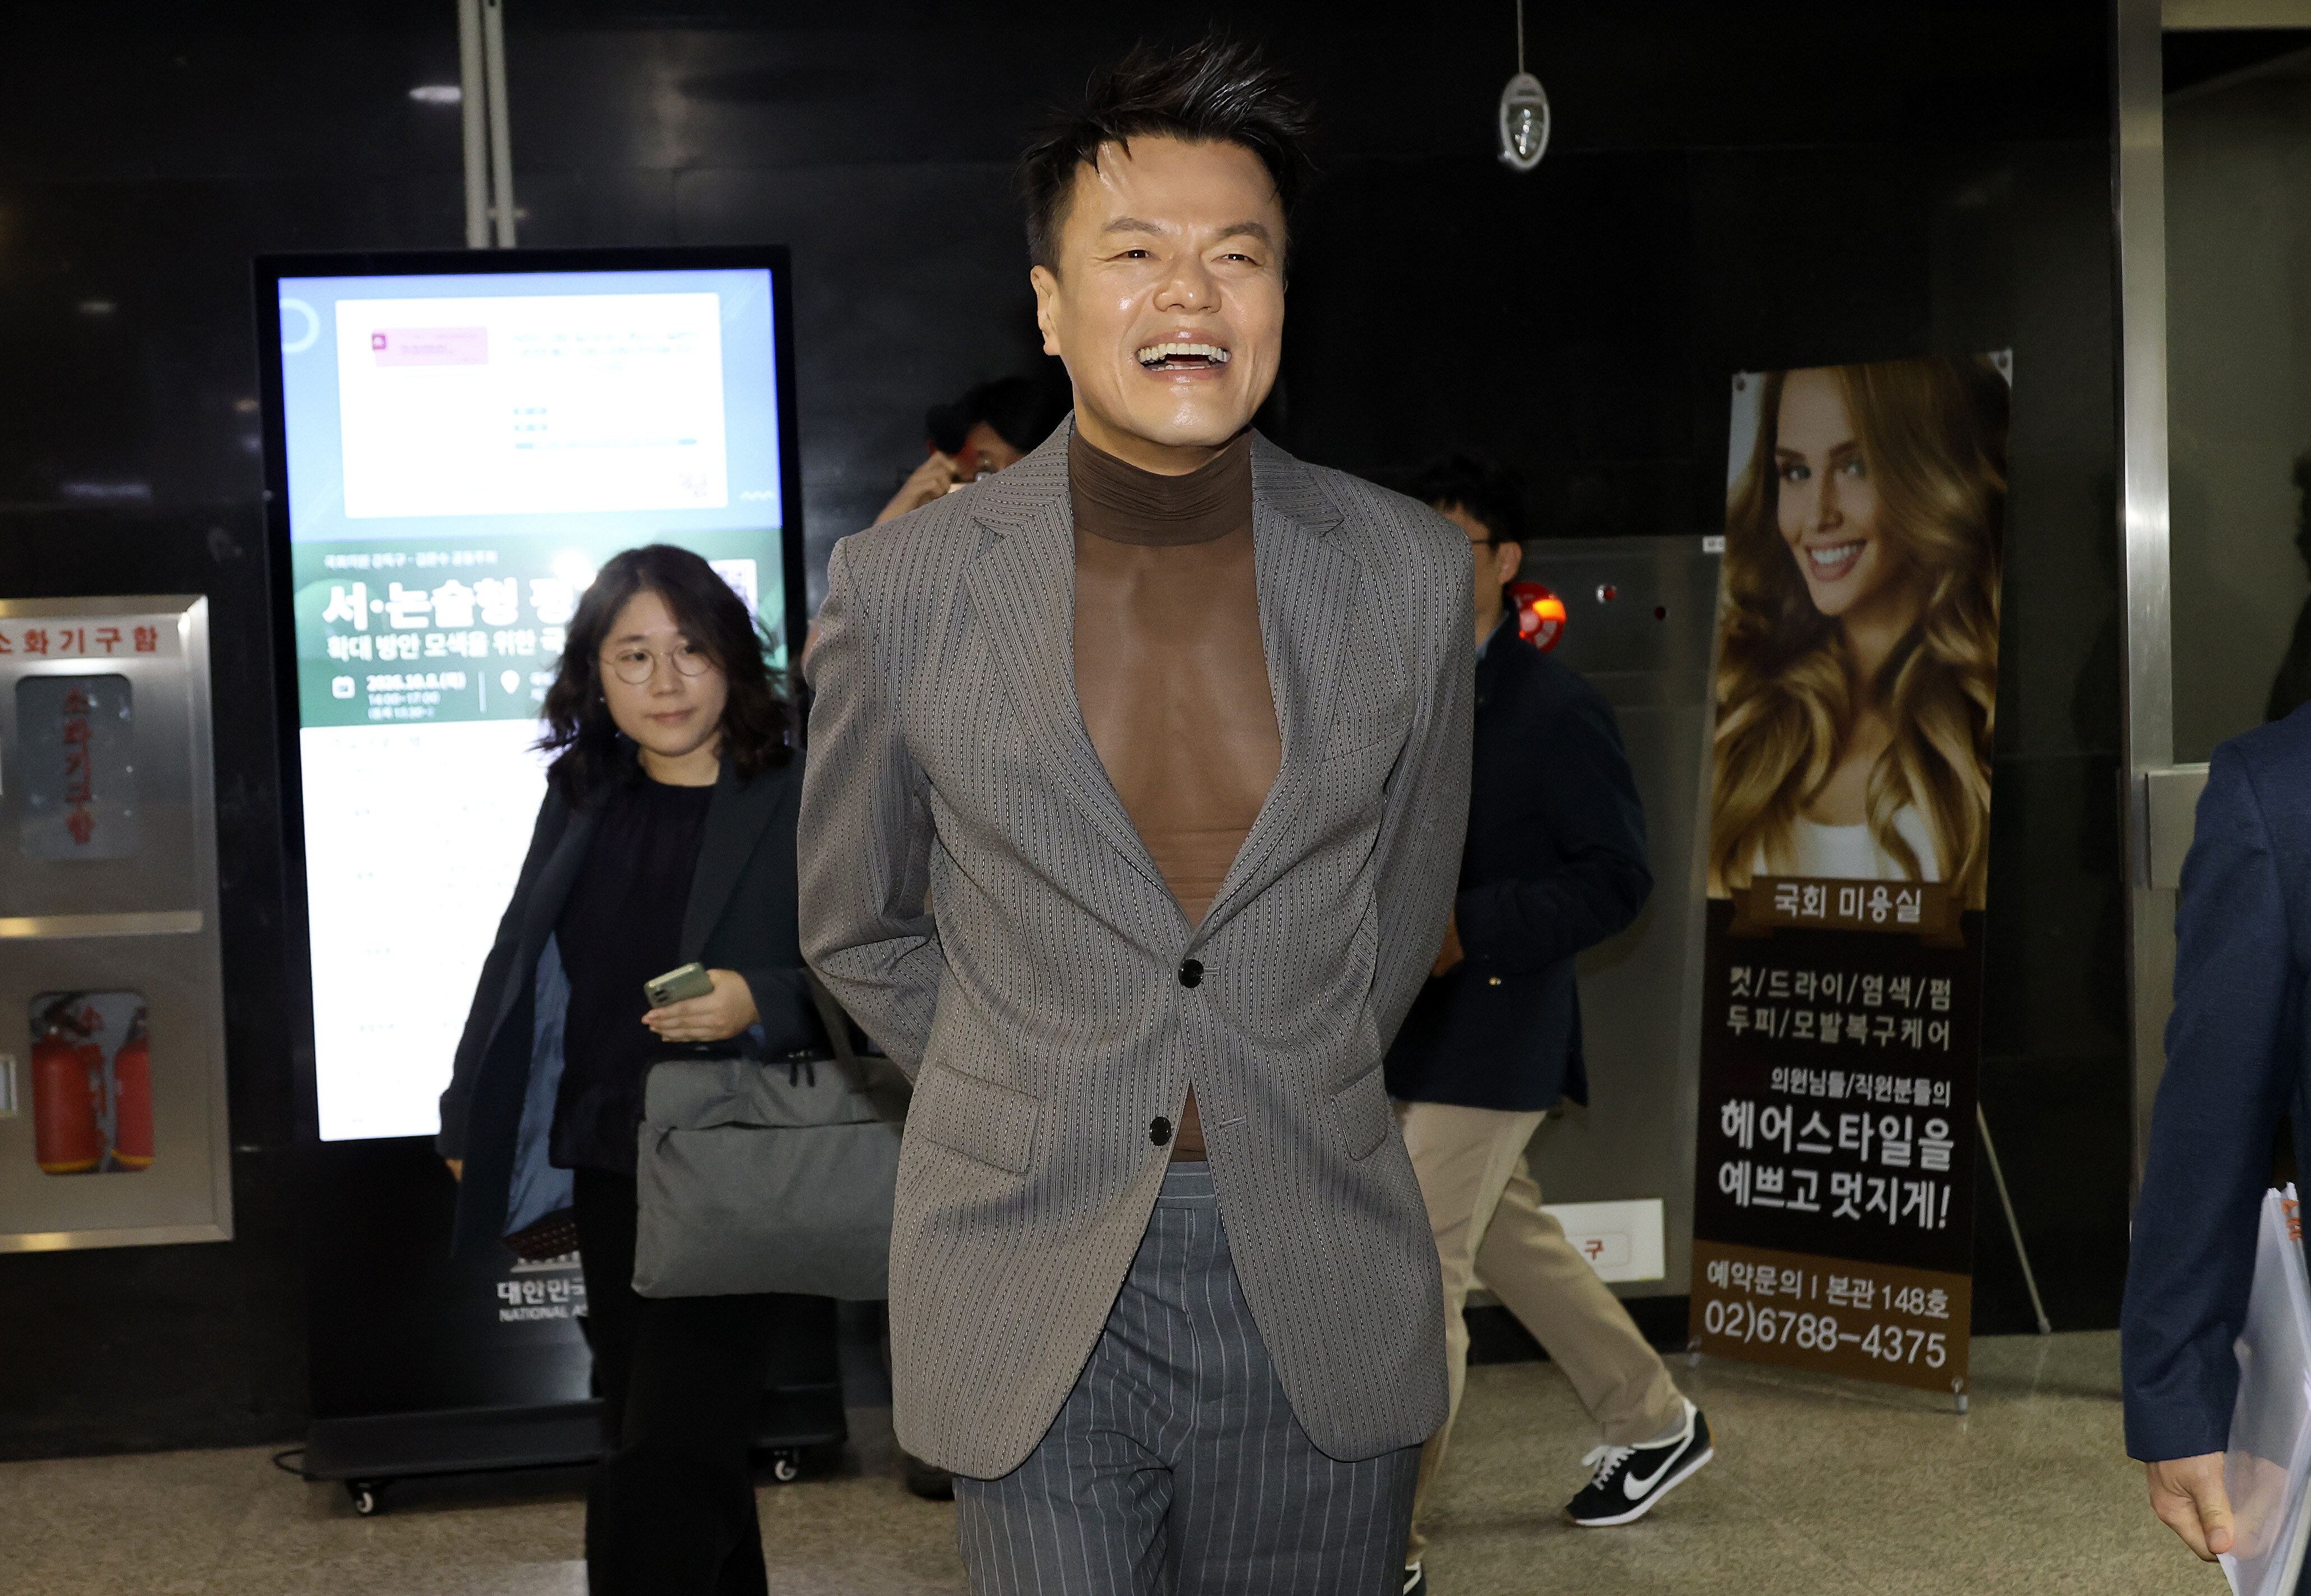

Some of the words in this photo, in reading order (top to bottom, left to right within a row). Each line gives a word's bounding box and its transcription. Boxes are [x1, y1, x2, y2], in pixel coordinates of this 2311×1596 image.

[327, 634, 373, 661] 확대
[375, 632, 421, 660] 방안
[424, 629, 489, 658] 모색을
[492, 628, 536, 656] 위한
[1774, 883, 1827, 919] 국회
[1839, 885, 1922, 924] 미용실
[1770, 1066, 1951, 1108] 의원님들/직원분들의
[1721, 1098, 1955, 1172] 헤어스타일을
[1719, 1160, 1821, 1212] 예쁘고
[1830, 1171, 1951, 1230] 멋지게!
[1707, 1259, 1803, 1300] 예약문의
[1827, 1274, 1874, 1310] 본관
[1881, 1284, 1950, 1319] 148호
[1704, 1299, 1947, 1369] 02)6788-4375
